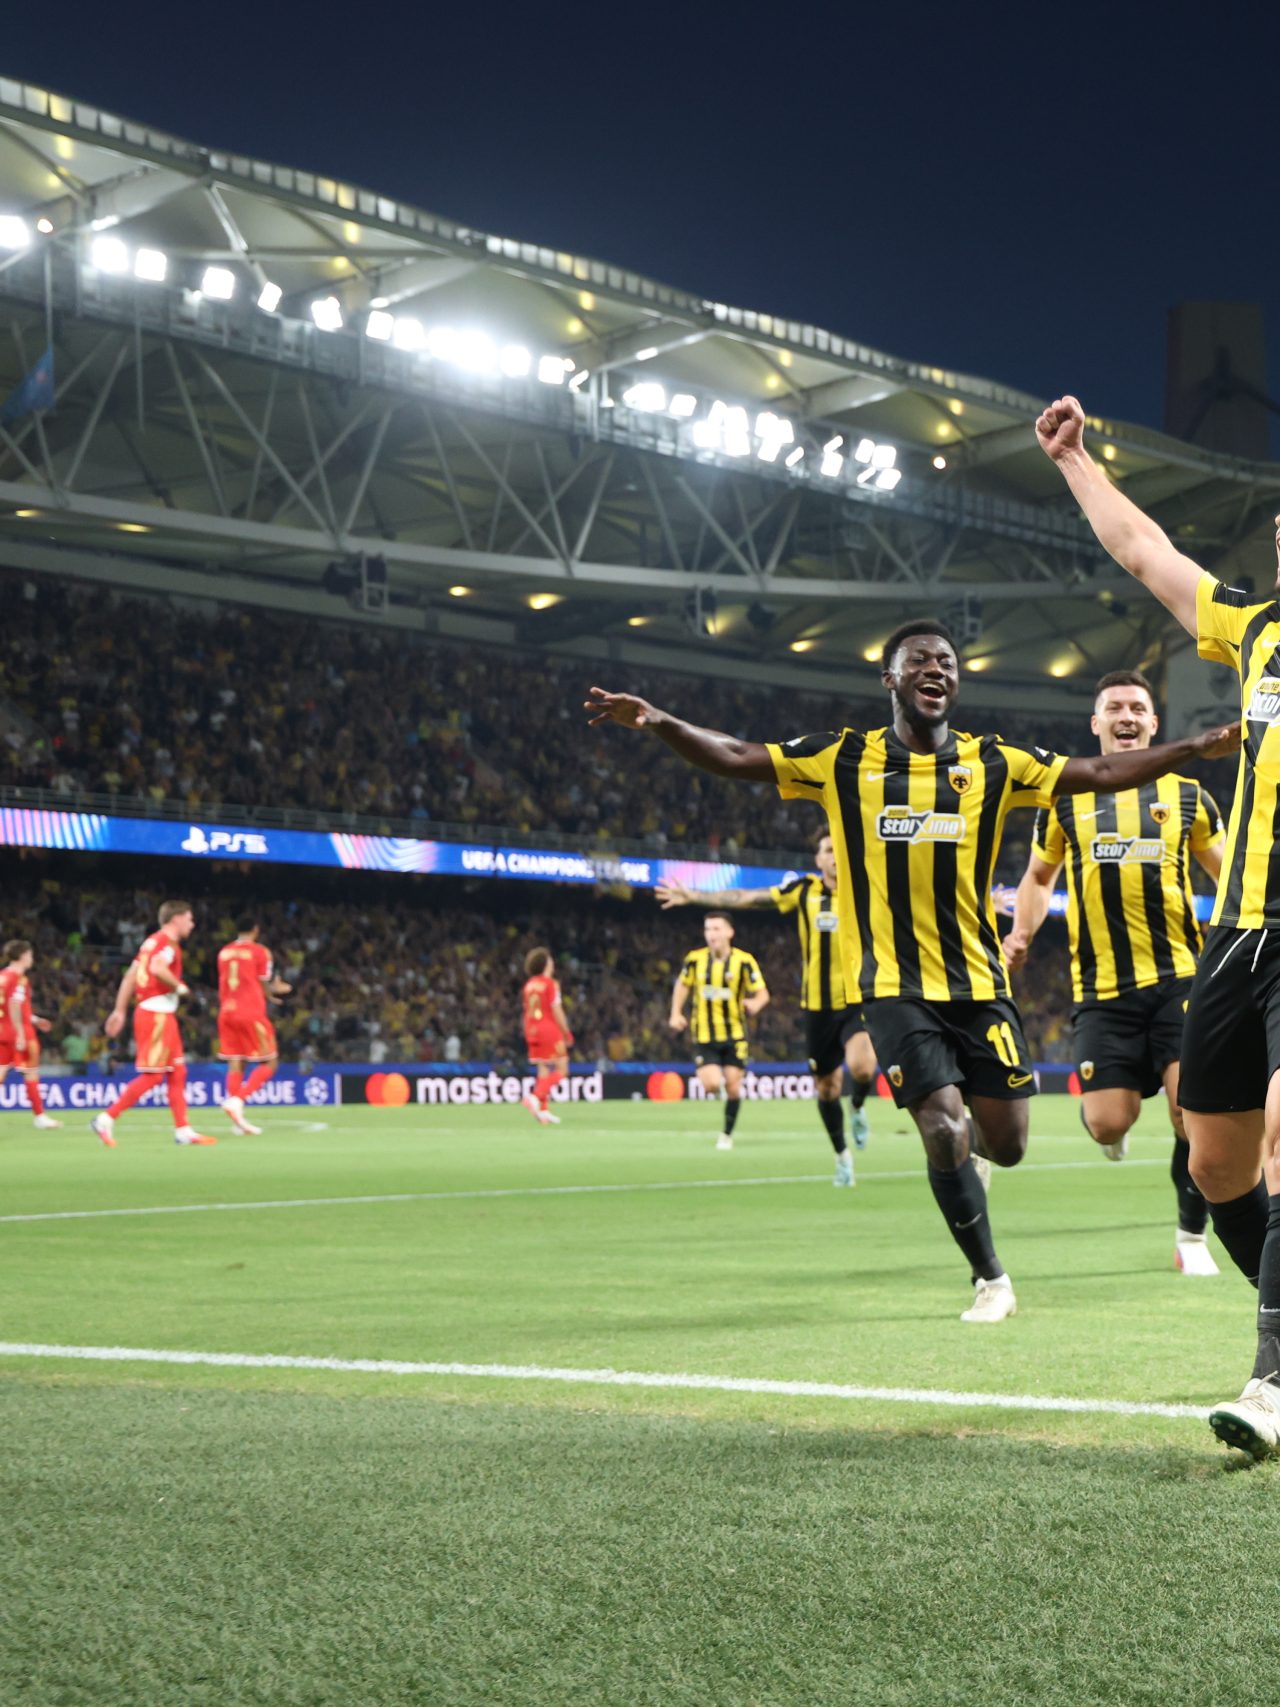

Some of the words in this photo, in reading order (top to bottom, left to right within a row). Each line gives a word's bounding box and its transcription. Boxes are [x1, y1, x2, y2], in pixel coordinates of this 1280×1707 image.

[986, 1021, 1020, 1068] 11
[213, 1080, 295, 1105] LGUE
[417, 1071, 603, 1104] masterard
